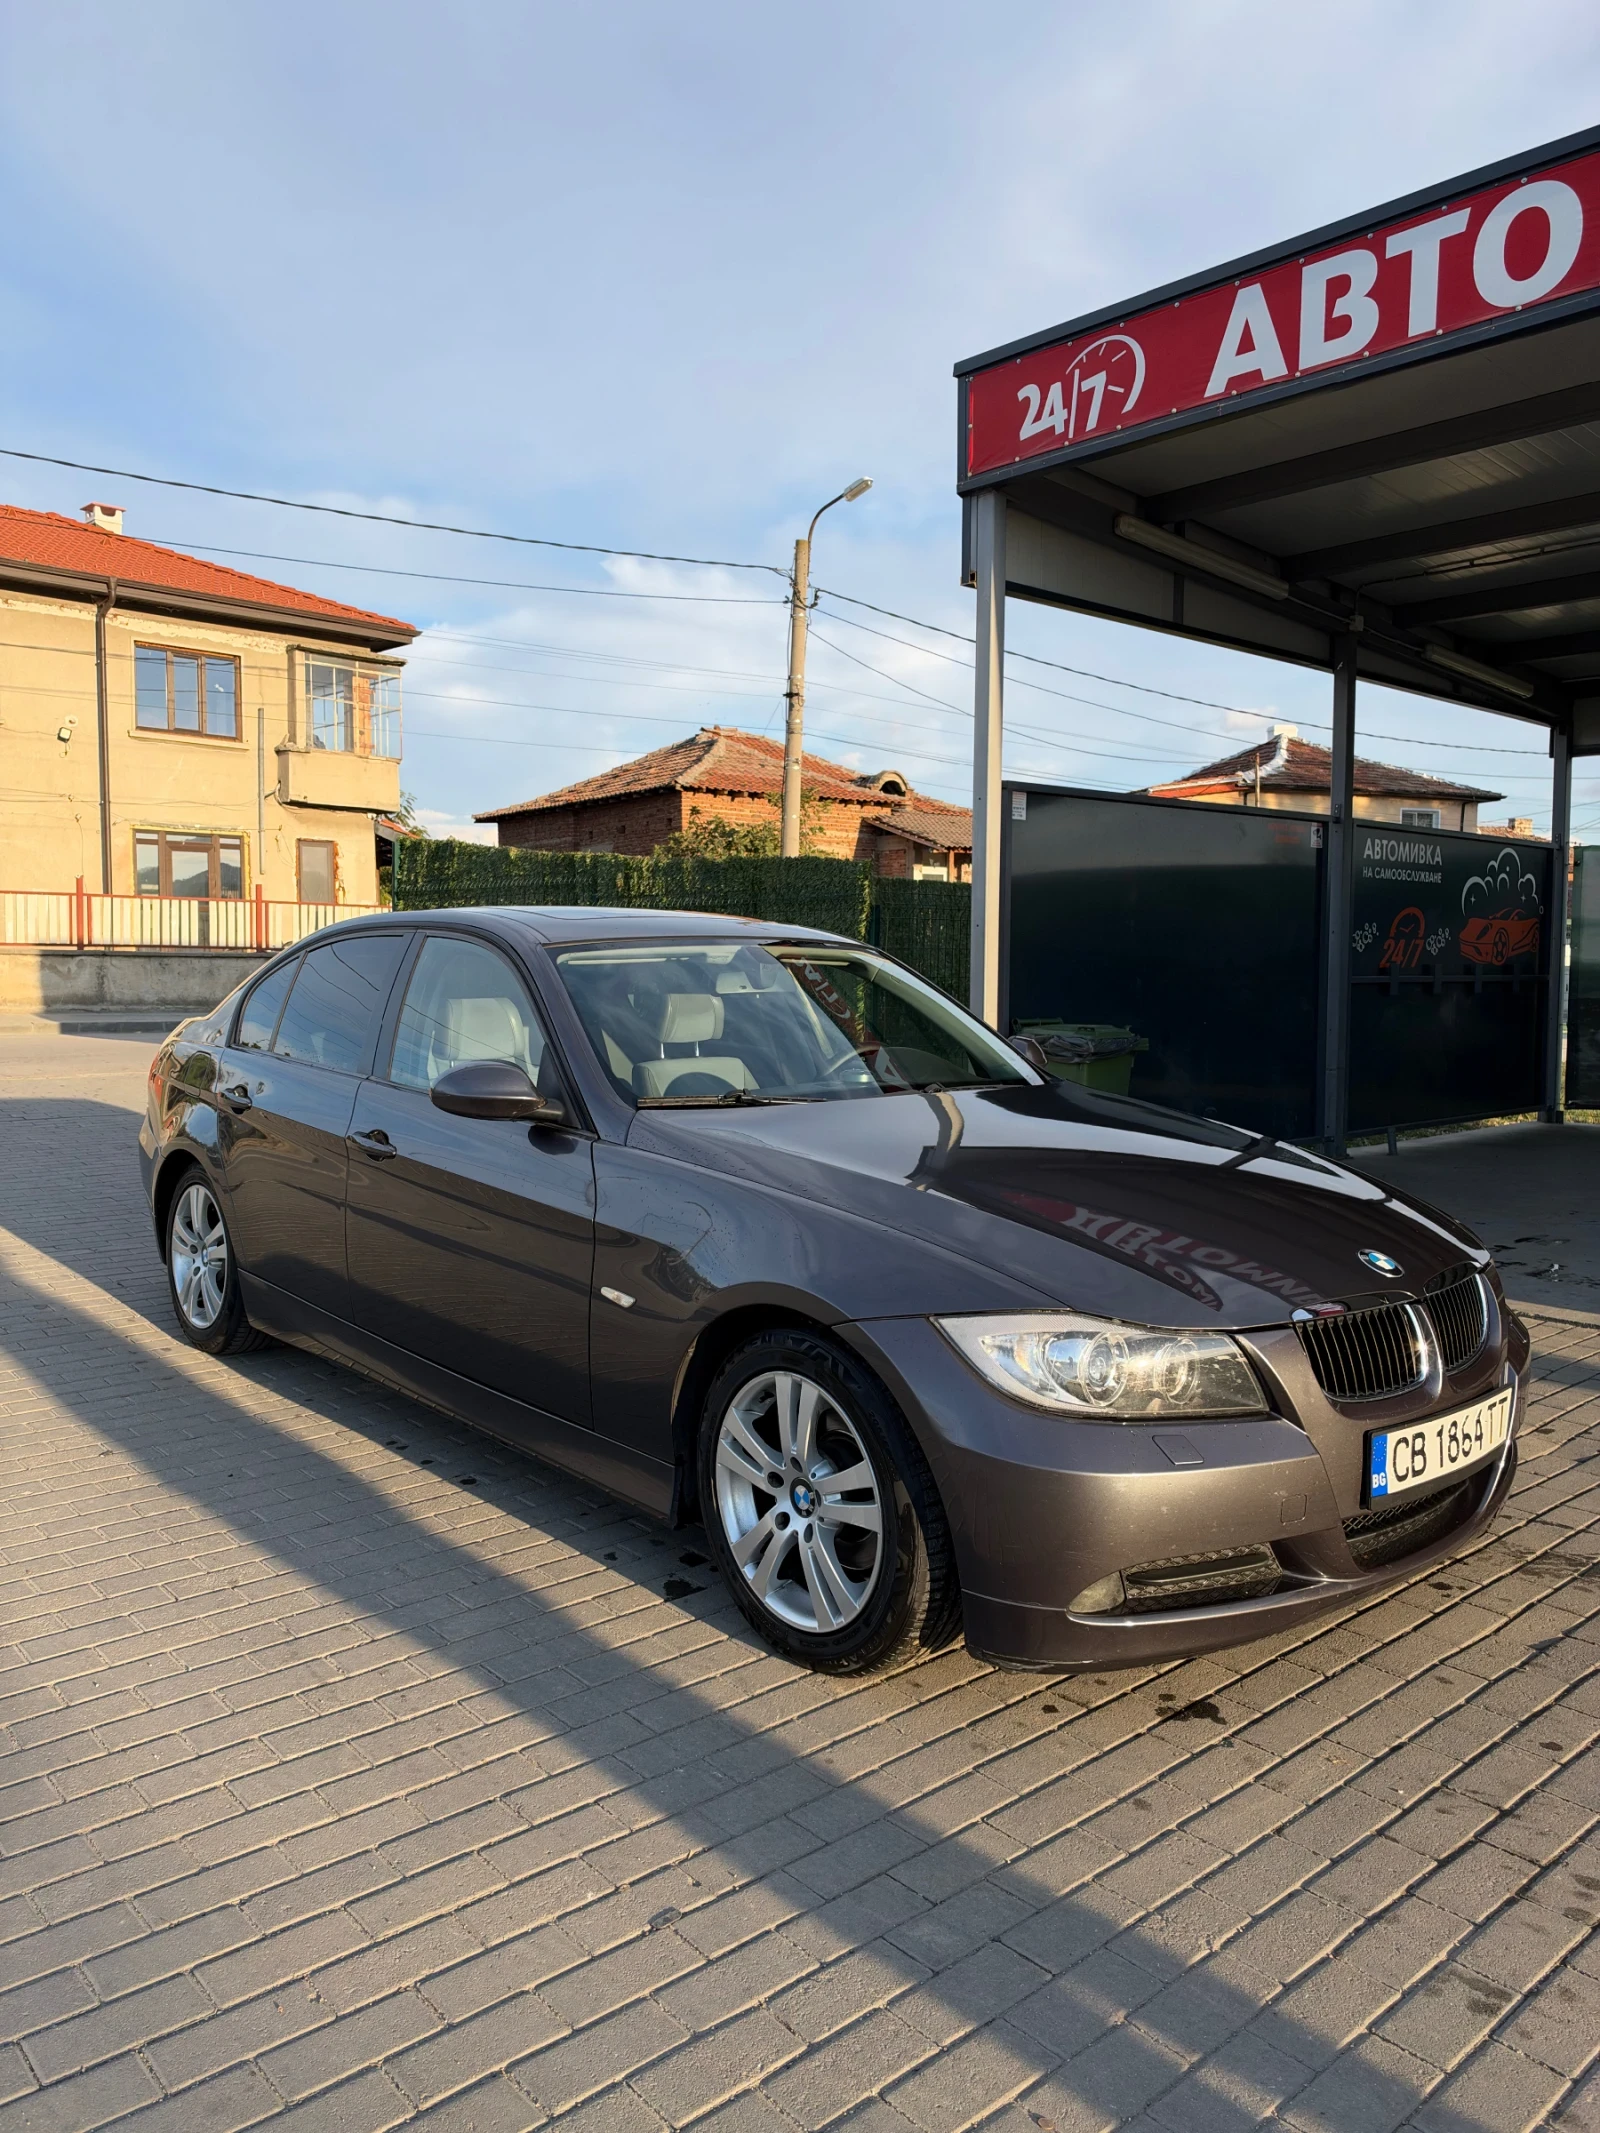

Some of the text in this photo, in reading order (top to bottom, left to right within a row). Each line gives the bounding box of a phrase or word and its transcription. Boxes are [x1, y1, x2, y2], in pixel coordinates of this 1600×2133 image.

[1017, 180, 1584, 442] 24/7 АВТО
[1363, 837, 1443, 866] АВТОМИВКА
[1362, 866, 1442, 884] НА САМООБСЛУЖВАНЕ
[1379, 938, 1425, 968] 24/7
[1392, 1396, 1508, 1482] CB 1864 TT
[1372, 1471, 1387, 1488] BG
